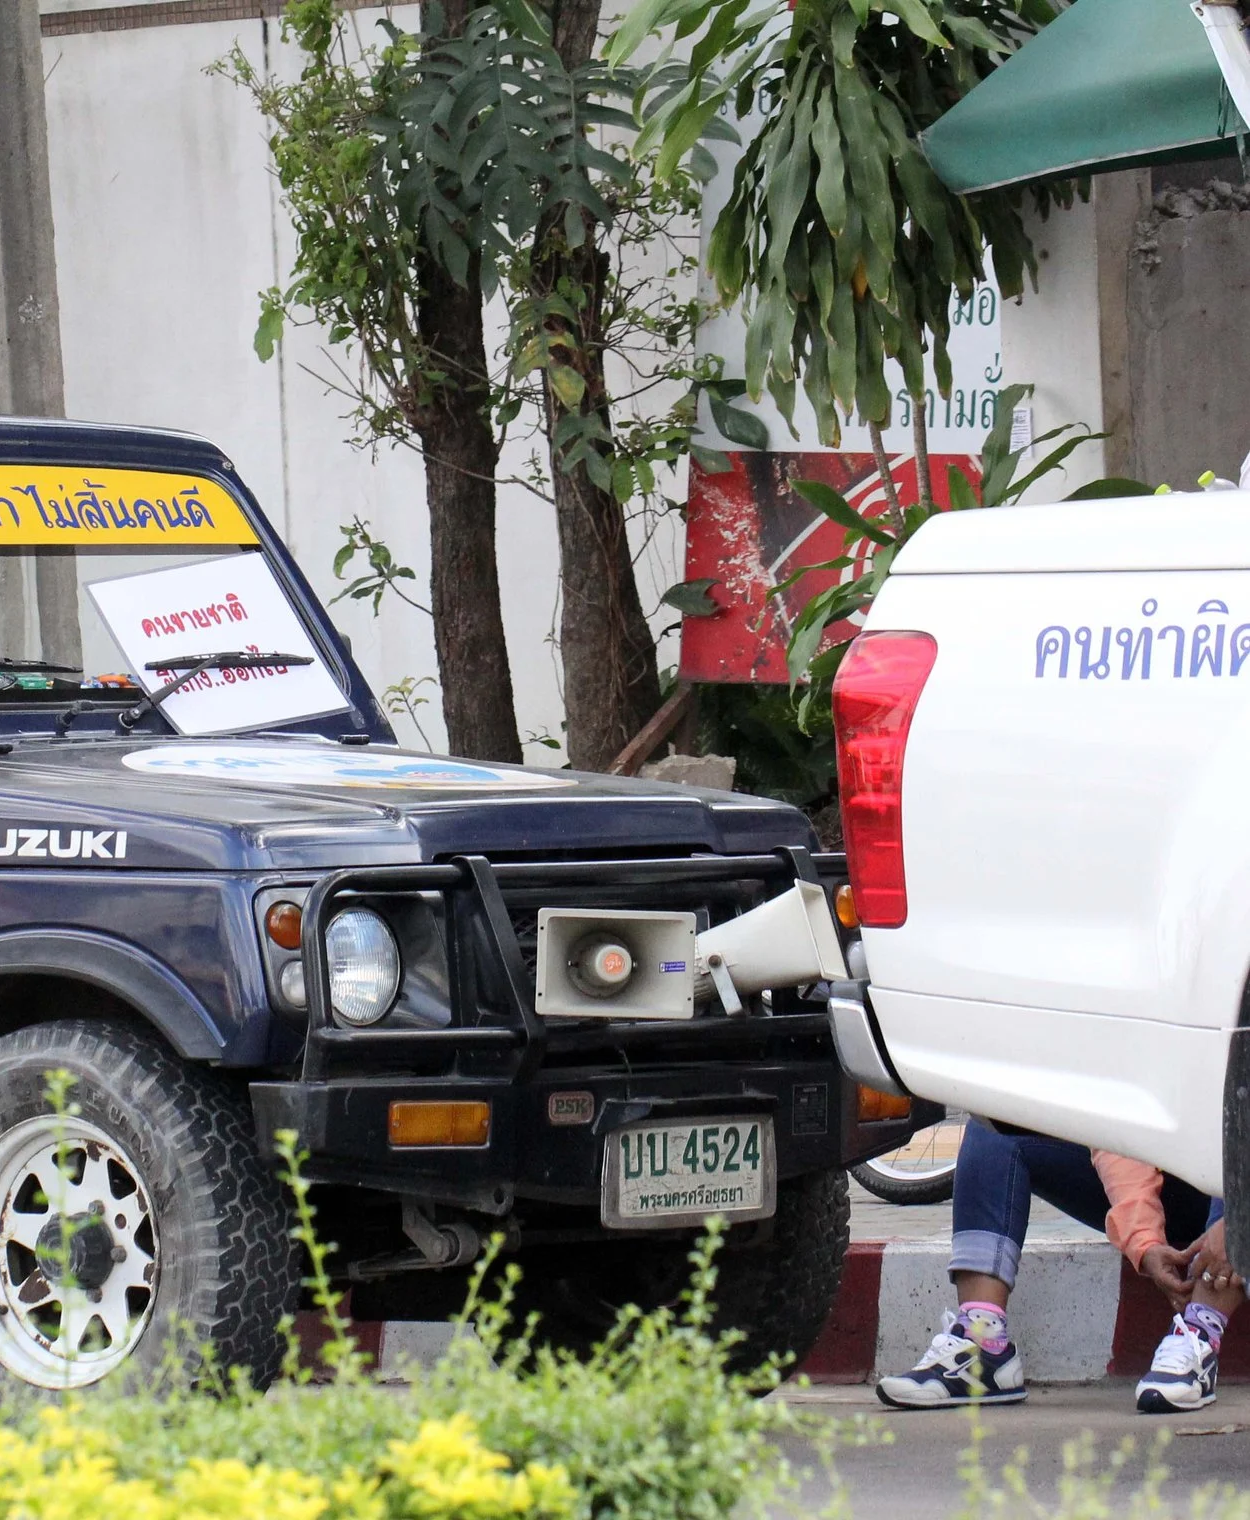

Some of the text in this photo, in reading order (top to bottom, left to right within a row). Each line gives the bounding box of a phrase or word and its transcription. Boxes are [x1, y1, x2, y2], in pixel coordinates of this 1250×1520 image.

[10, 479, 215, 532] ไม่สิ้นคนดี
[141, 593, 248, 638] คนขายชาติ
[682, 1125, 760, 1174] 4524
[639, 1184, 743, 1209] พระนครศรีอยุธยา
